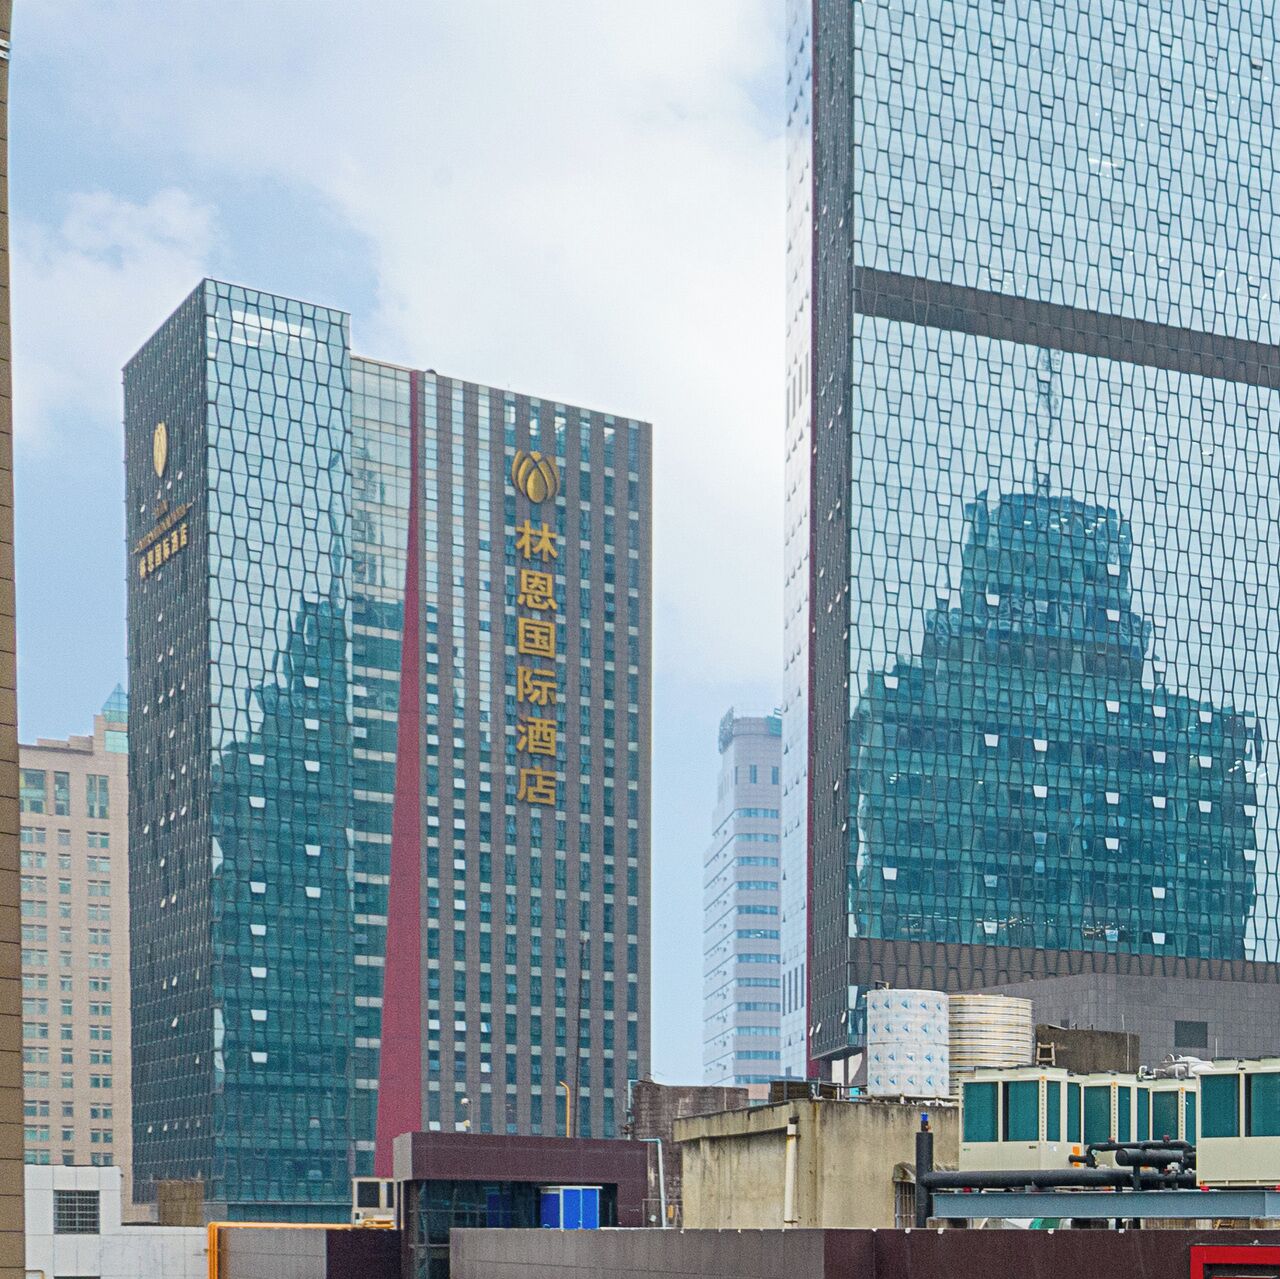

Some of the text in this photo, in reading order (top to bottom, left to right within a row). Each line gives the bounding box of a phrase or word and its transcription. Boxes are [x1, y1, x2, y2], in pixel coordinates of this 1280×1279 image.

[515, 519, 558, 806] 林恩国际酒店
